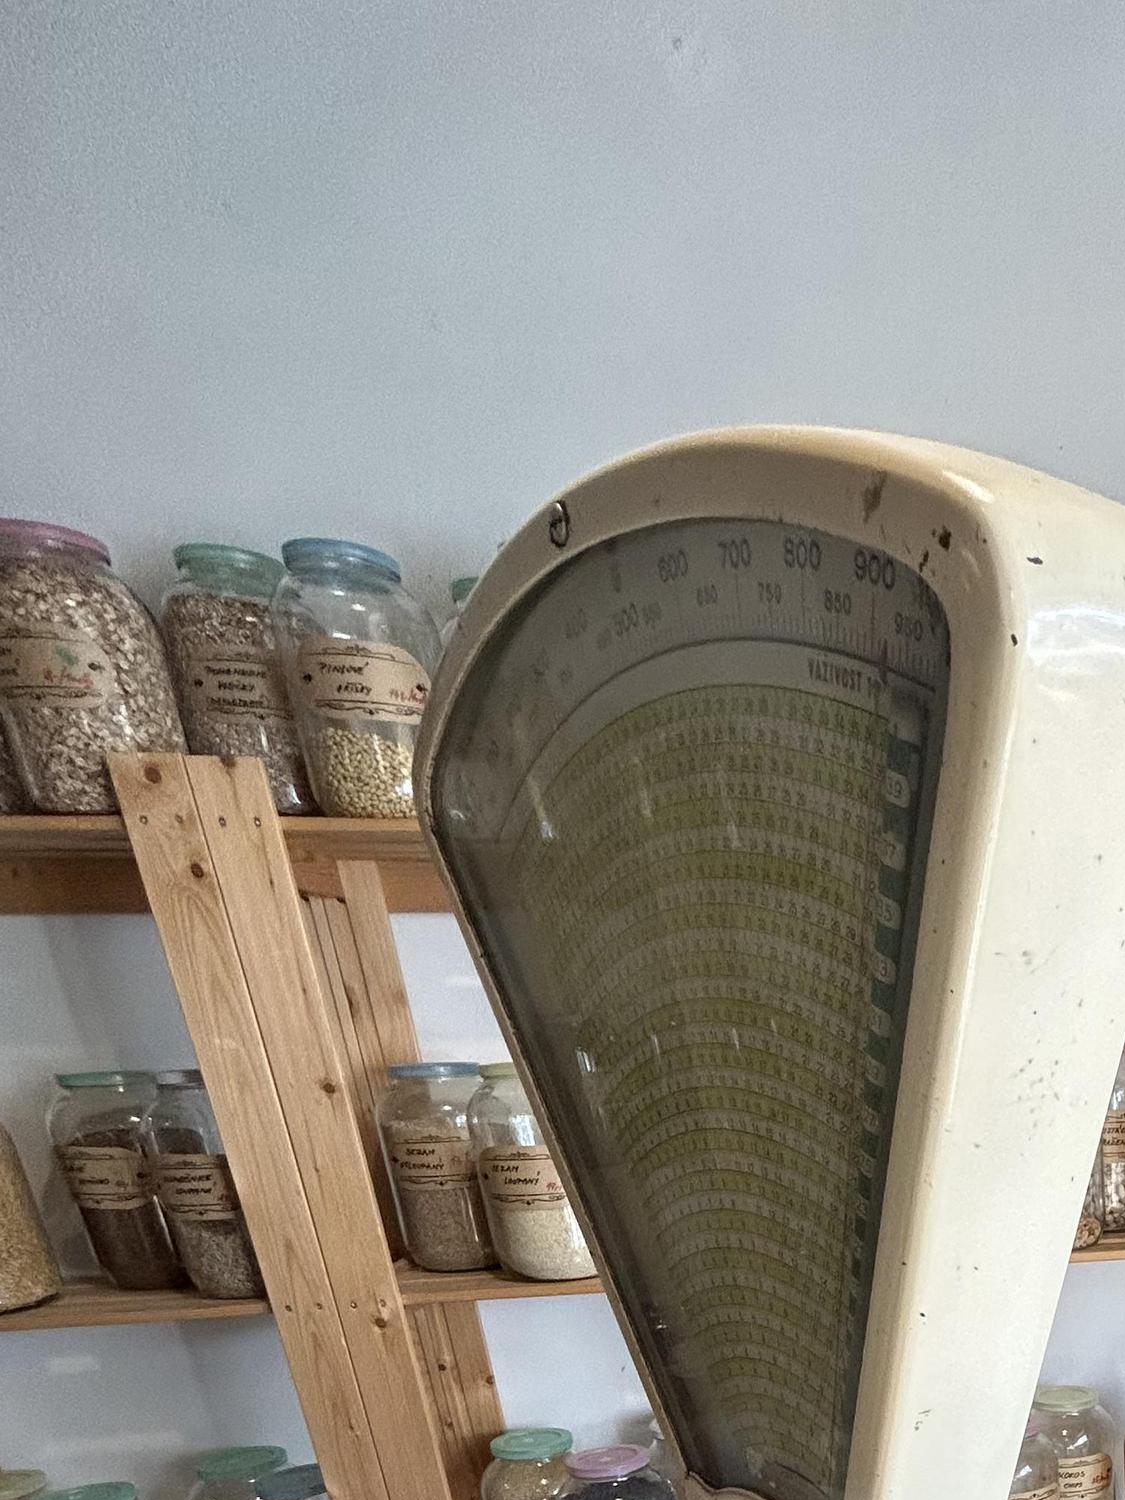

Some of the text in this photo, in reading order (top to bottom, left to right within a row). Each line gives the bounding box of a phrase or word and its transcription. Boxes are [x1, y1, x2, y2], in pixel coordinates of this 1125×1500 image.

[719, 538, 752, 570] 700
[782, 538, 823, 571] 800
[853, 552, 896, 591] 900
[824, 590, 852, 616] 850
[894, 611, 926, 642] 950
[1058, 1470, 1086, 1480] KOKOS
